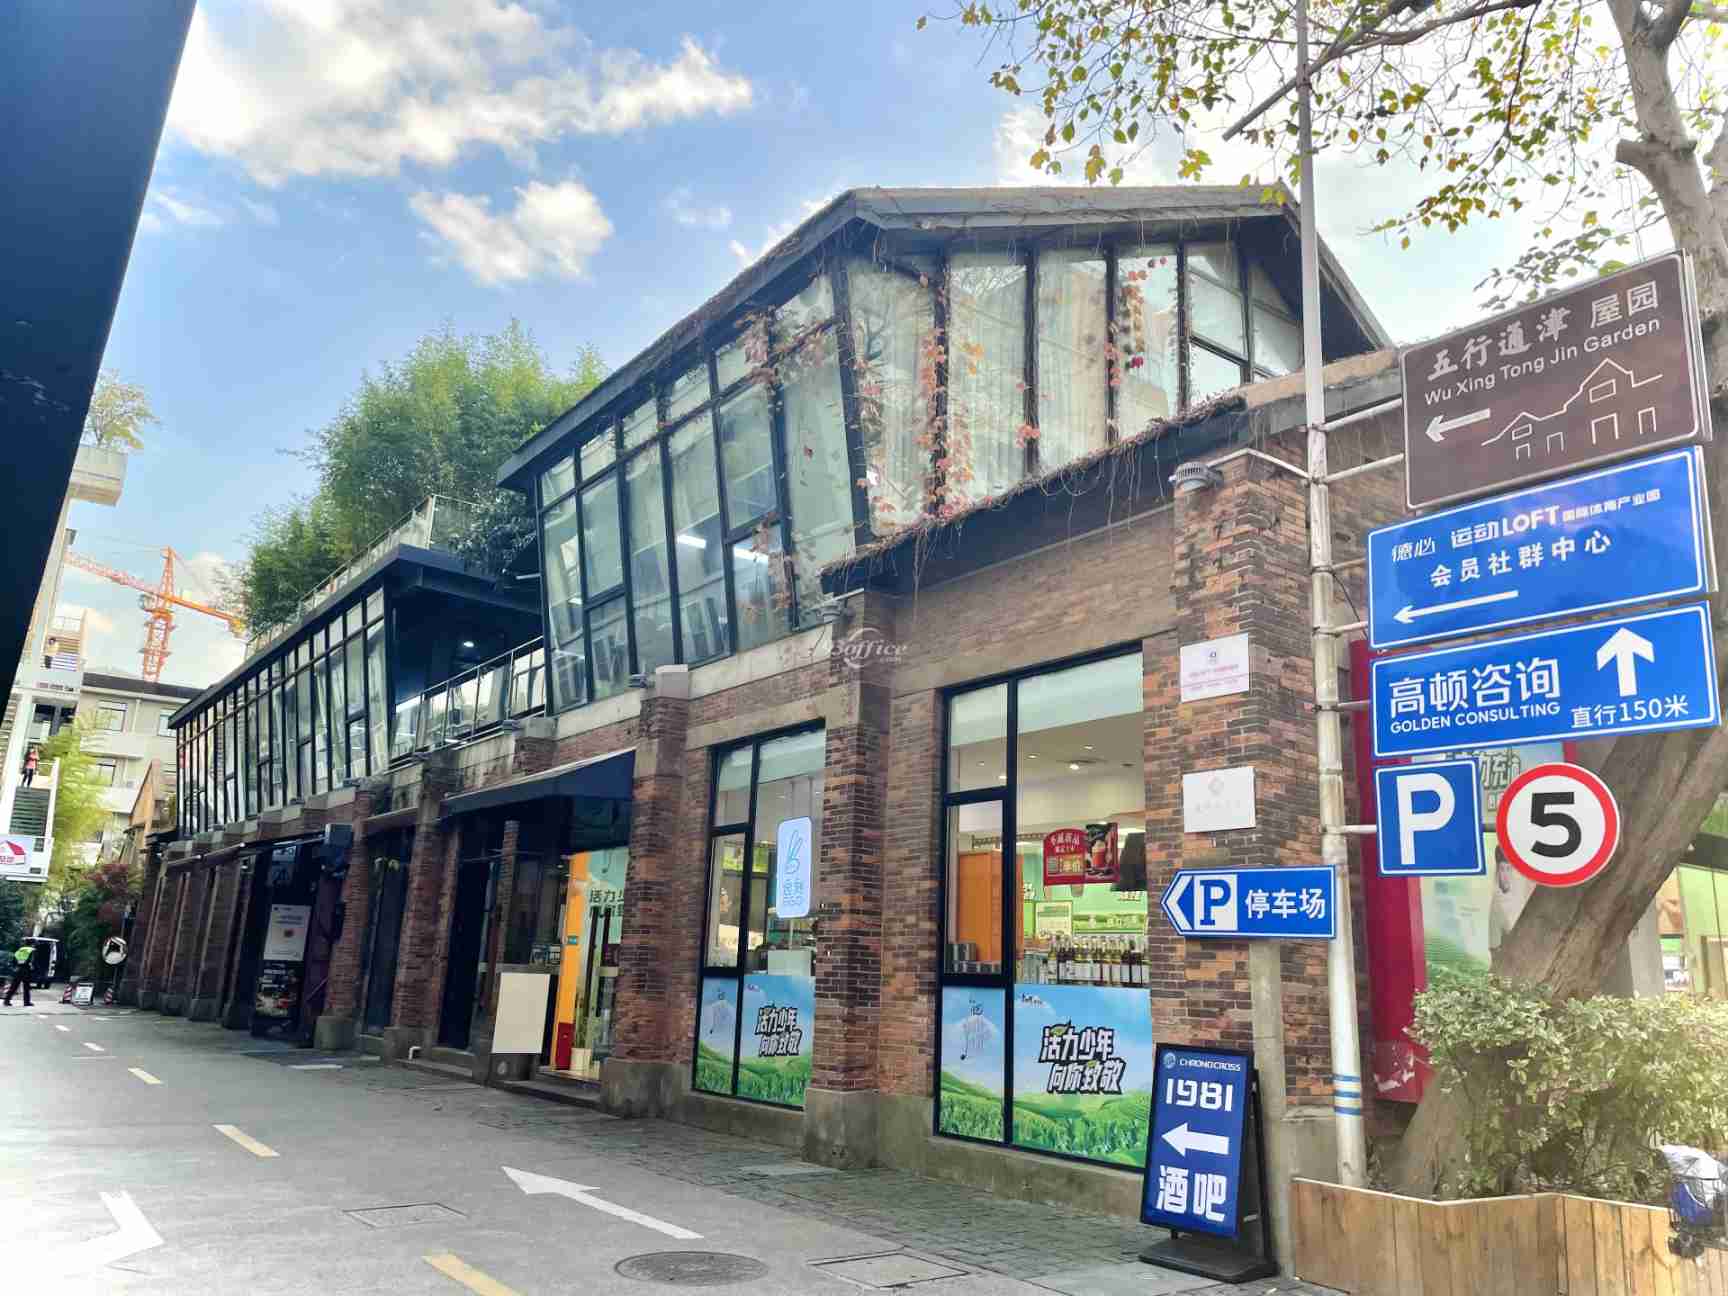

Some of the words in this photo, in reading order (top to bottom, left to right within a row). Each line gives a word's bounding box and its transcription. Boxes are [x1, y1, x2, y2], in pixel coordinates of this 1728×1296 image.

[1425, 389, 1452, 406] Wu
[1456, 371, 1496, 396] Xing
[1500, 355, 1545, 381] Tong
[1550, 346, 1578, 366] Jin
[1584, 318, 1661, 353] Garden
[1430, 530, 1612, 588] 会员社群中心
[1389, 656, 1561, 719] 高顿咨询
[1571, 694, 1689, 729] 直行150米
[1390, 715, 1451, 735] GOLDEN
[1455, 701, 1561, 727] CONSULTING
[1396, 772, 1455, 866] P
[1530, 791, 1582, 858] 5
[1199, 879, 1232, 927] P
[1245, 888, 1326, 920] 停车场
[1040, 1023, 1115, 1062] 活力少年
[1047, 1058, 1126, 1095] 向你致敬
[1166, 1077, 1234, 1112] 1981
[1155, 1164, 1227, 1223] 酒吧
